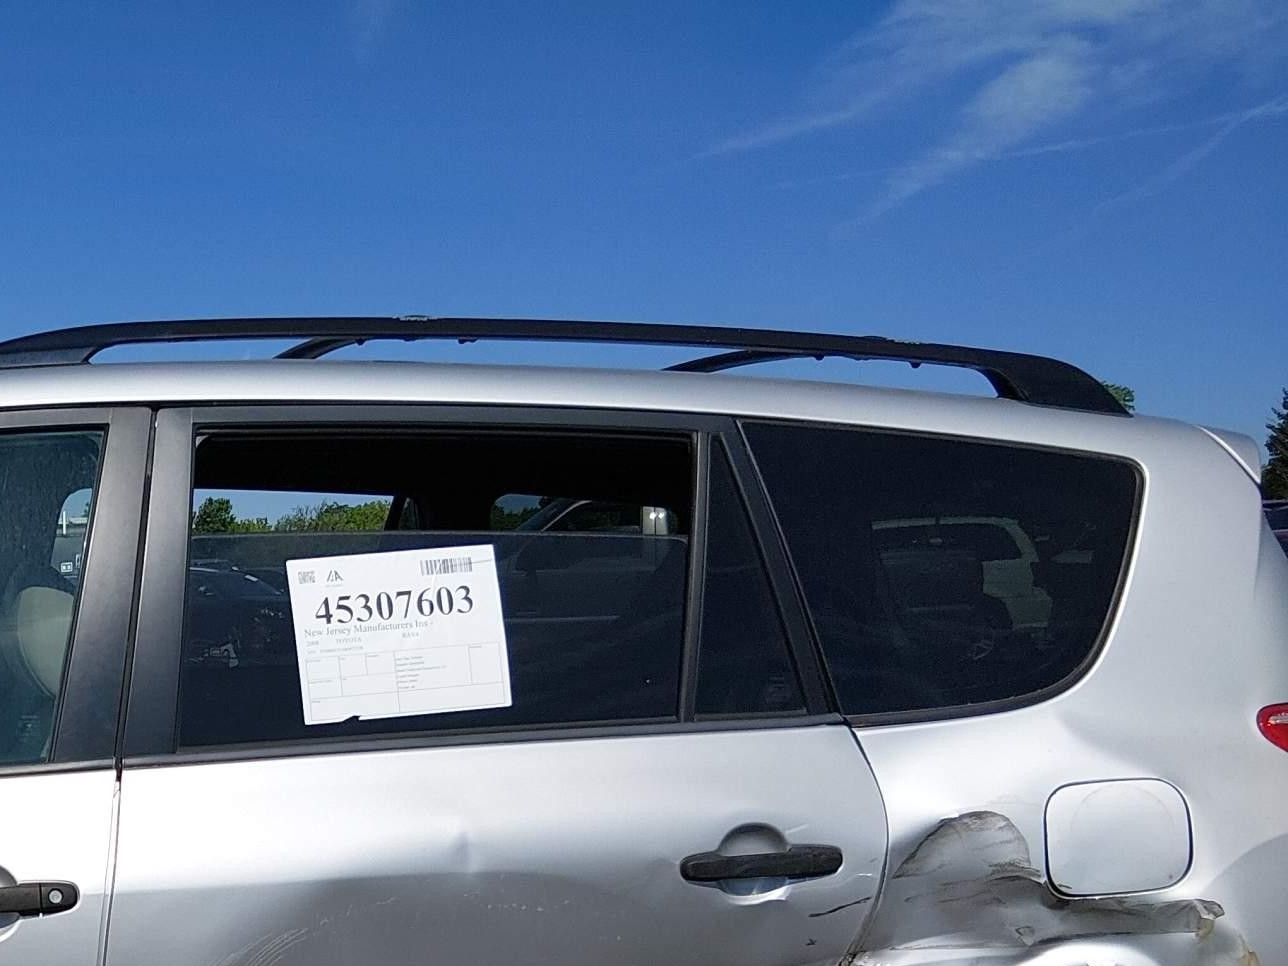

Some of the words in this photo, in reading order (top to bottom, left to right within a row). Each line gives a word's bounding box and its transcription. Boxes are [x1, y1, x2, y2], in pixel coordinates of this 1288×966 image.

[315, 585, 474, 625] 45307603
[304, 628, 322, 638] New
[326, 625, 351, 637] Jersey
[353, 621, 413, 633] Manufacturers
